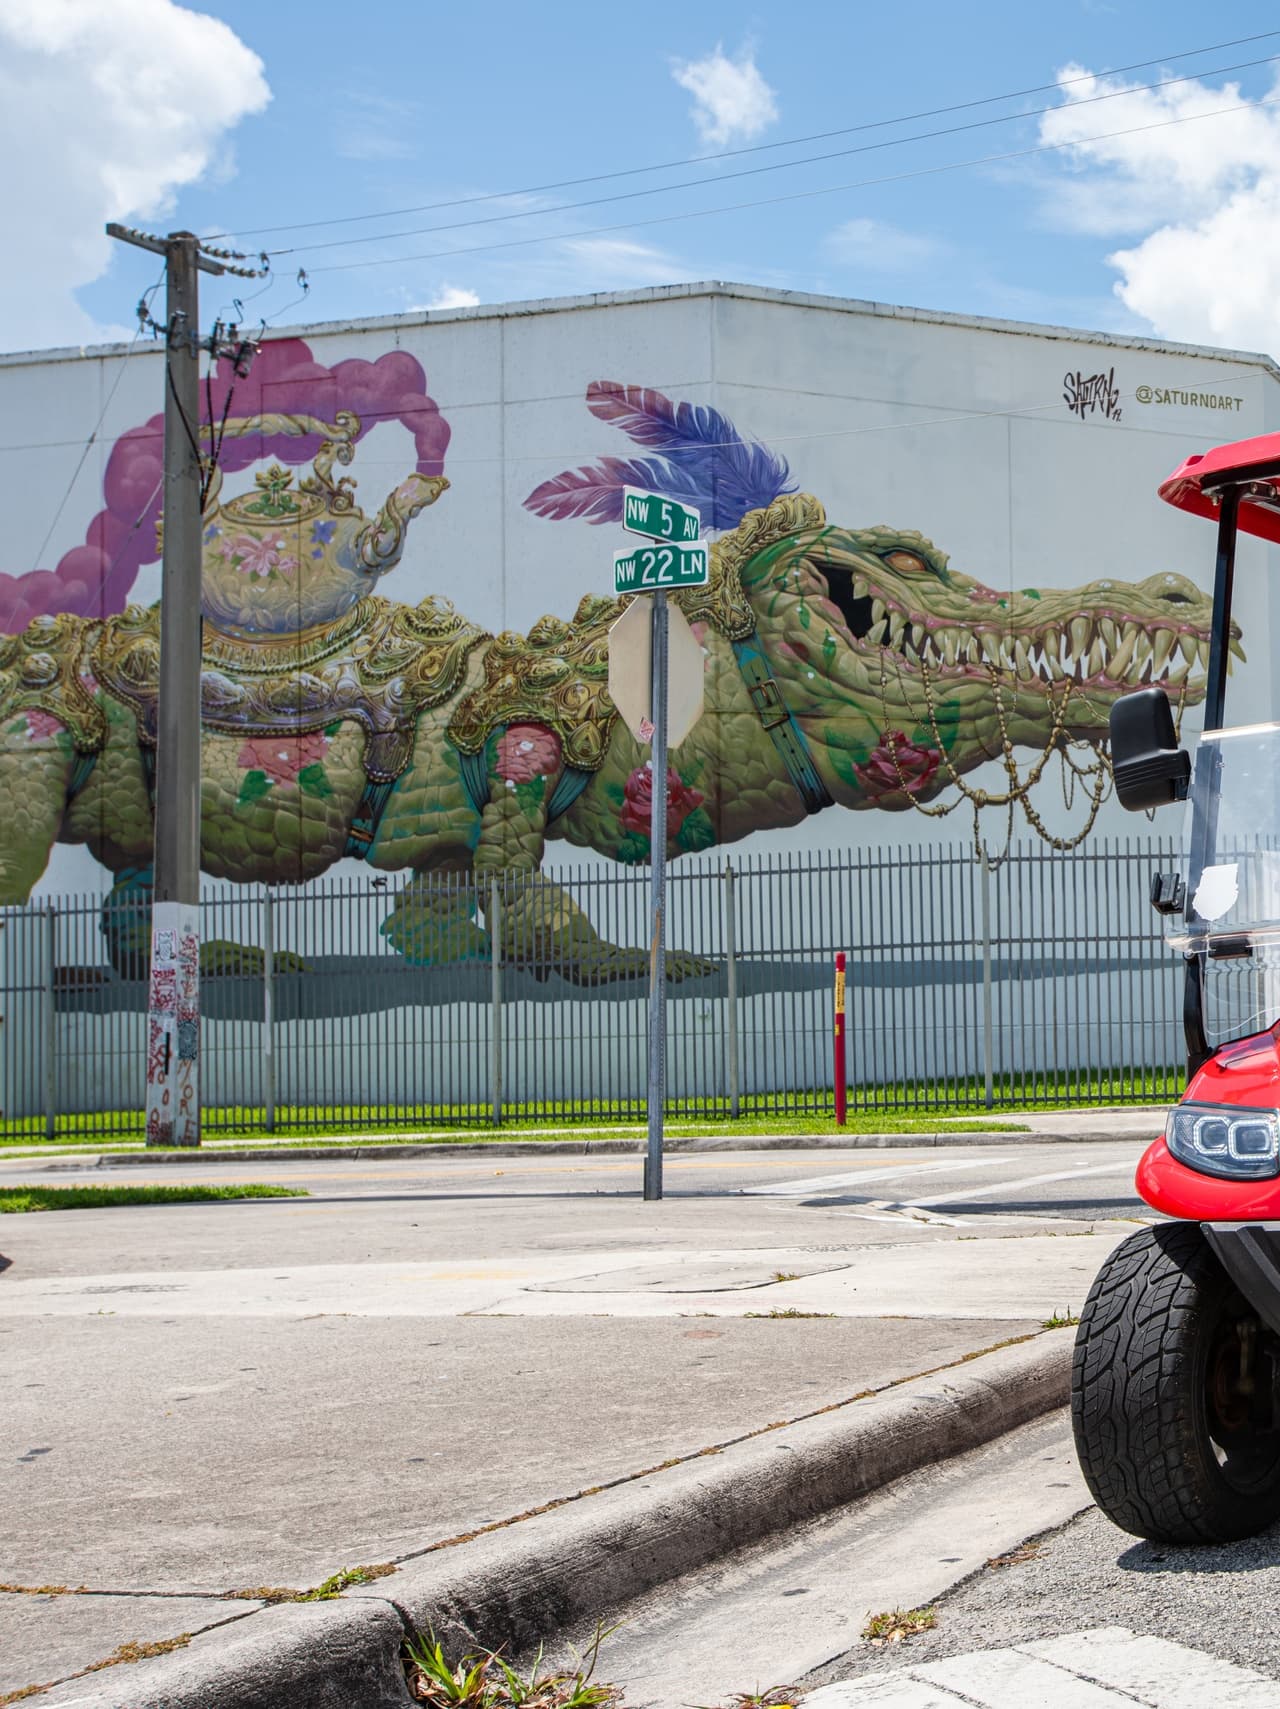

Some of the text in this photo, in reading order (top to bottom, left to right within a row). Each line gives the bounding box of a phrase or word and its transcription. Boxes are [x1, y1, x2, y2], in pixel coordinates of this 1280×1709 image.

[1136, 385, 1243, 411] @SATURNOART
[628, 498, 697, 540] NW 5 AV
[617, 549, 703, 584] NW 22 LN
